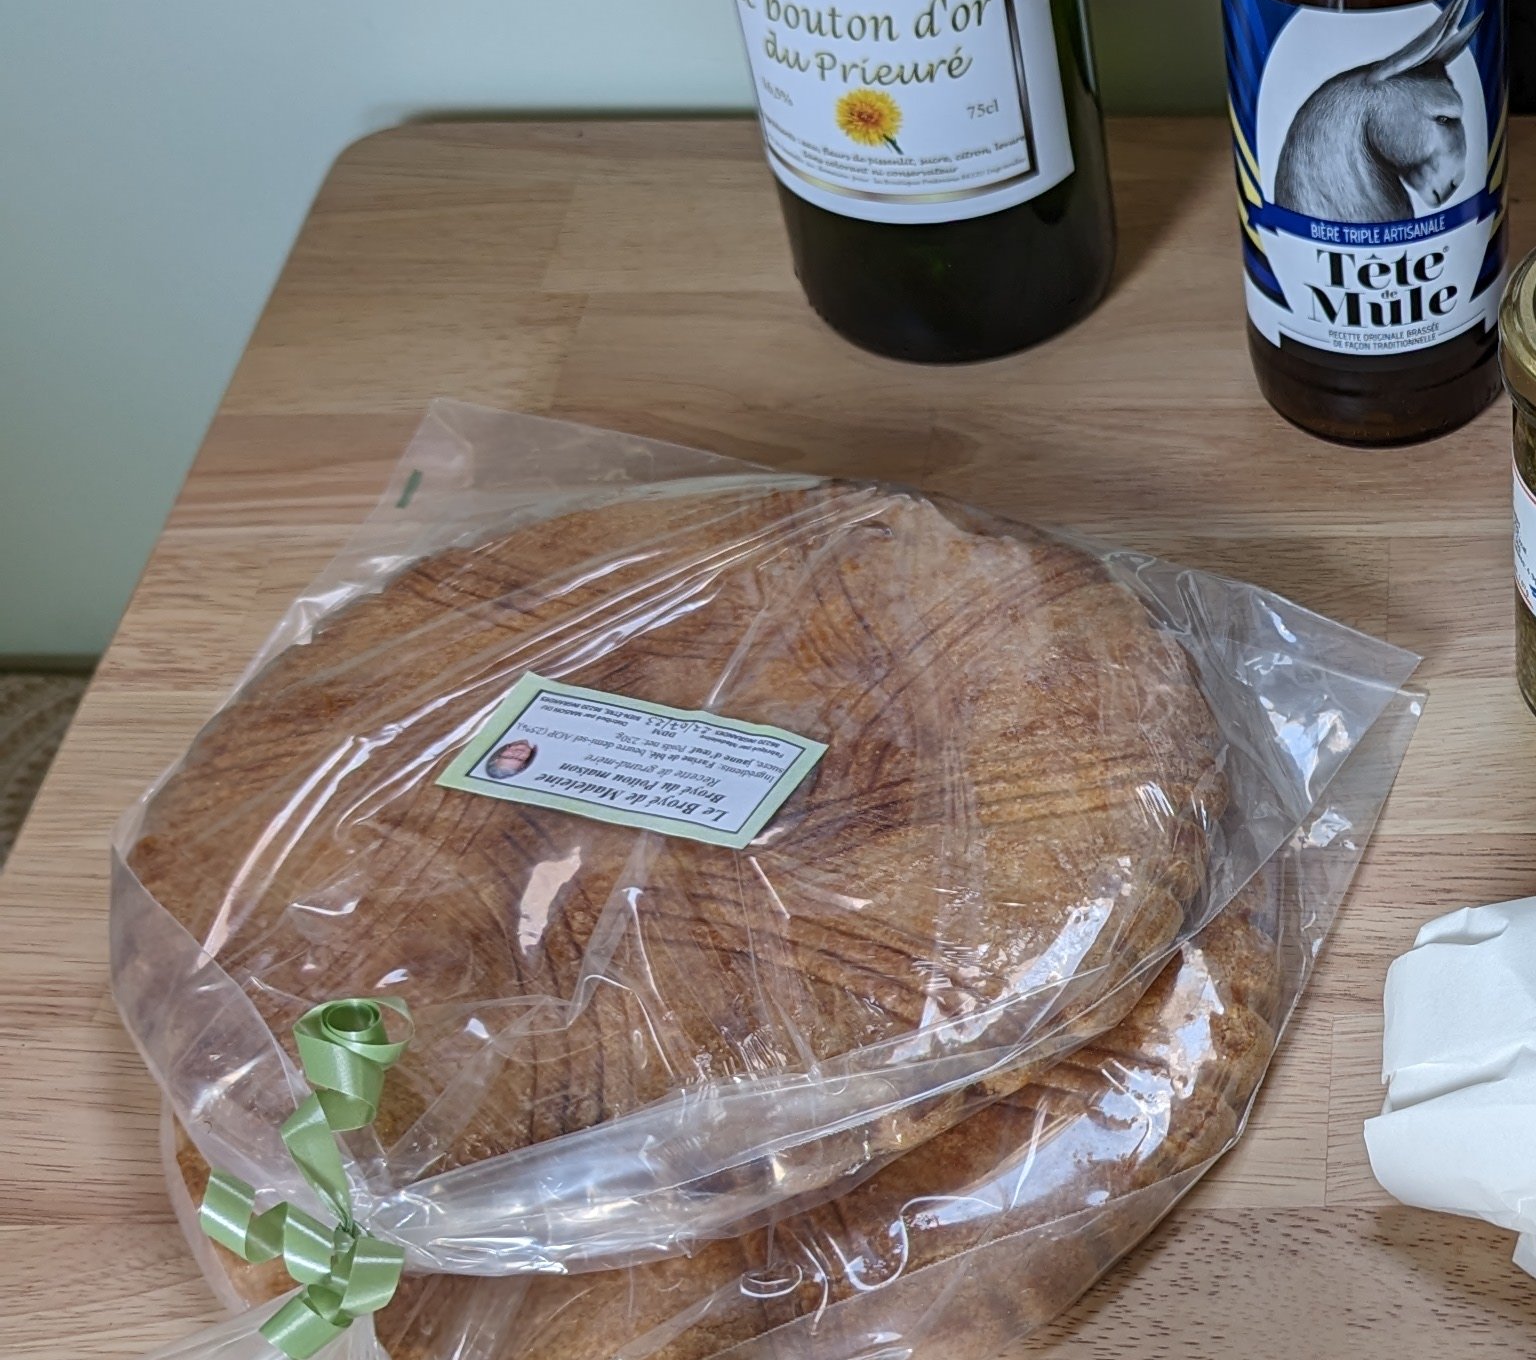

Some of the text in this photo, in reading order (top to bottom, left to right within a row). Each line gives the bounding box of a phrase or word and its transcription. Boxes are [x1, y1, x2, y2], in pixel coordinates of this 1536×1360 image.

[765, 30, 973, 86] du Prieuré
[966, 97, 999, 120] 75cl
[1310, 216, 1446, 243] BIÈRE TRIPLE ARTISANALE
[1316, 248, 1445, 290] Tête
[1381, 290, 1398, 300] de
[1304, 285, 1458, 329] Mule
[1329, 329, 1362, 341] RECETTE
[1345, 340, 1370, 351] FAÇON
[549, 728, 573, 741] AOP
[574, 733, 614, 750] demi-sel
[616, 743, 646, 757] beurre
[666, 752, 681, 762] de
[682, 755, 715, 770] Farine
[723, 753, 754, 768] jaune
[584, 753, 721, 788] Recette de grand-mère
[559, 762, 727, 804] Broyé du Poitou maison
[534, 772, 729, 823] Le Broyé de Madeleine
